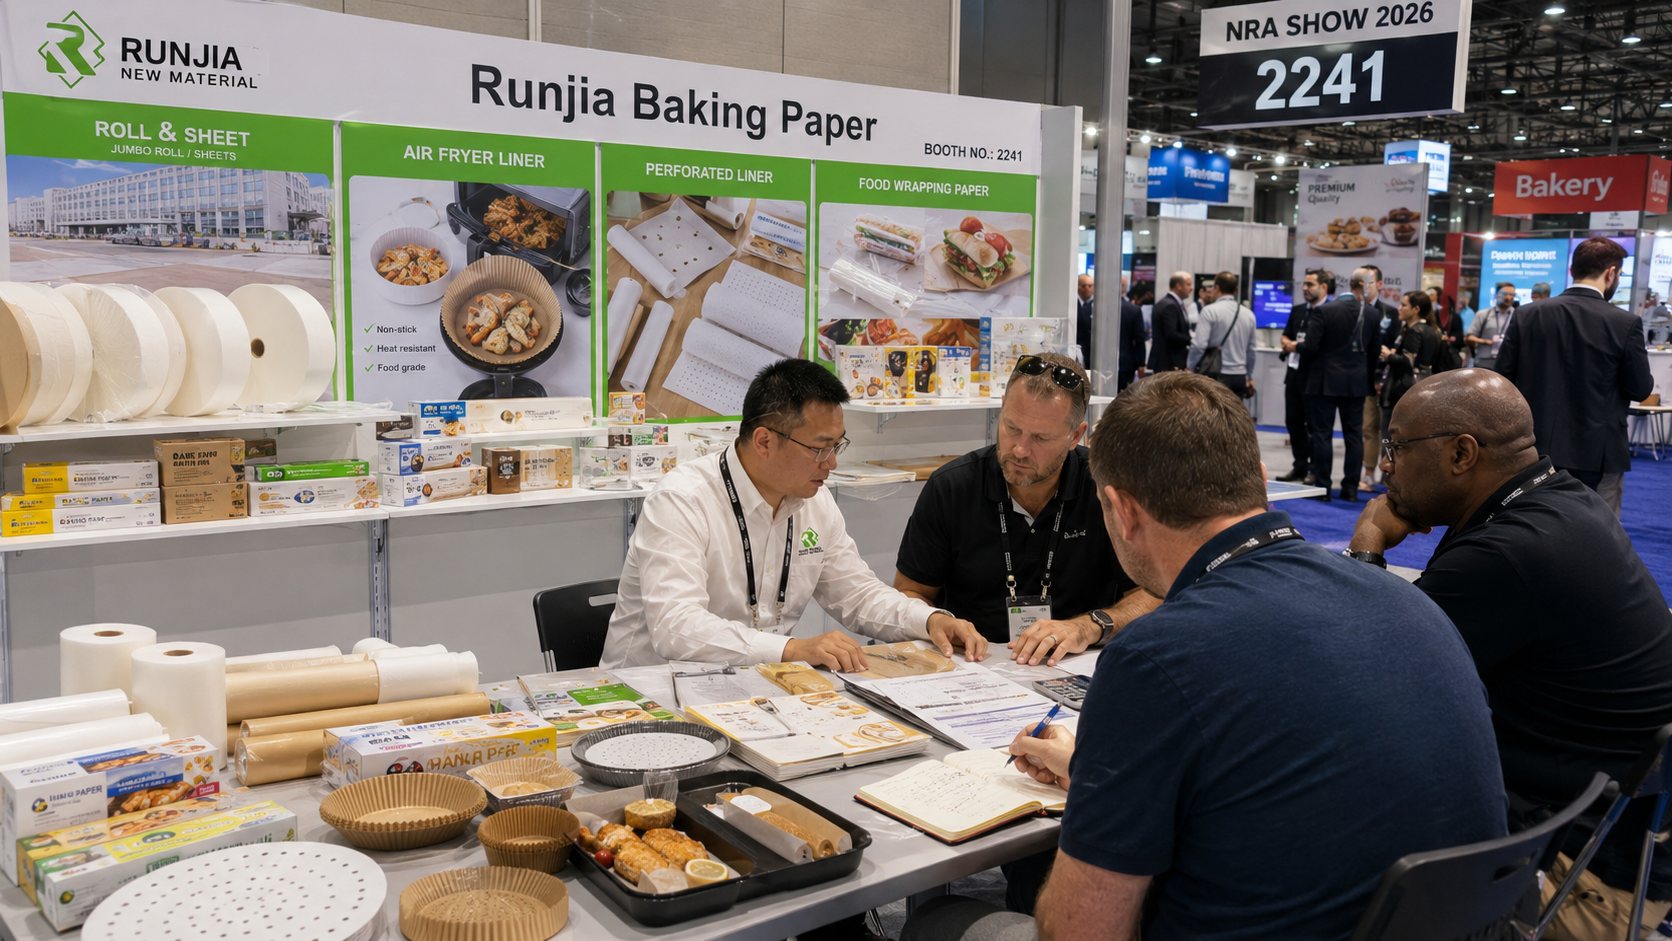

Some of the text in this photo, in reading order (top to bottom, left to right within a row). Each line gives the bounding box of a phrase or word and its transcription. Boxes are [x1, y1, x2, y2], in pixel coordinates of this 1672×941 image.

[1226, 1, 1434, 42] NRA SHOW 2026
[121, 37, 242, 71] RUNJIA
[121, 68, 258, 89] NEW MATERIAL
[1255, 50, 1386, 111] 2241
[471, 64, 878, 146] Runjia Baking Paper
[95, 120, 250, 148] ROLL & SHEET
[111, 144, 237, 161] JUMBO ROLL / SHEETS
[403, 144, 545, 169] AIR FRYER LINER
[924, 143, 1023, 162] BOOTH NO.: 2241
[645, 162, 774, 184] PERFORATED LINER
[859, 177, 989, 197] FOOD WRAPPING PAPER
[1308, 183, 1356, 193] PREMIUM
[1515, 172, 1614, 201] Bakery
[1308, 194, 1341, 205] Quality
[377, 325, 417, 334] Non-stick
[377, 345, 436, 353] Heat resistant
[378, 363, 426, 373] Food grade
